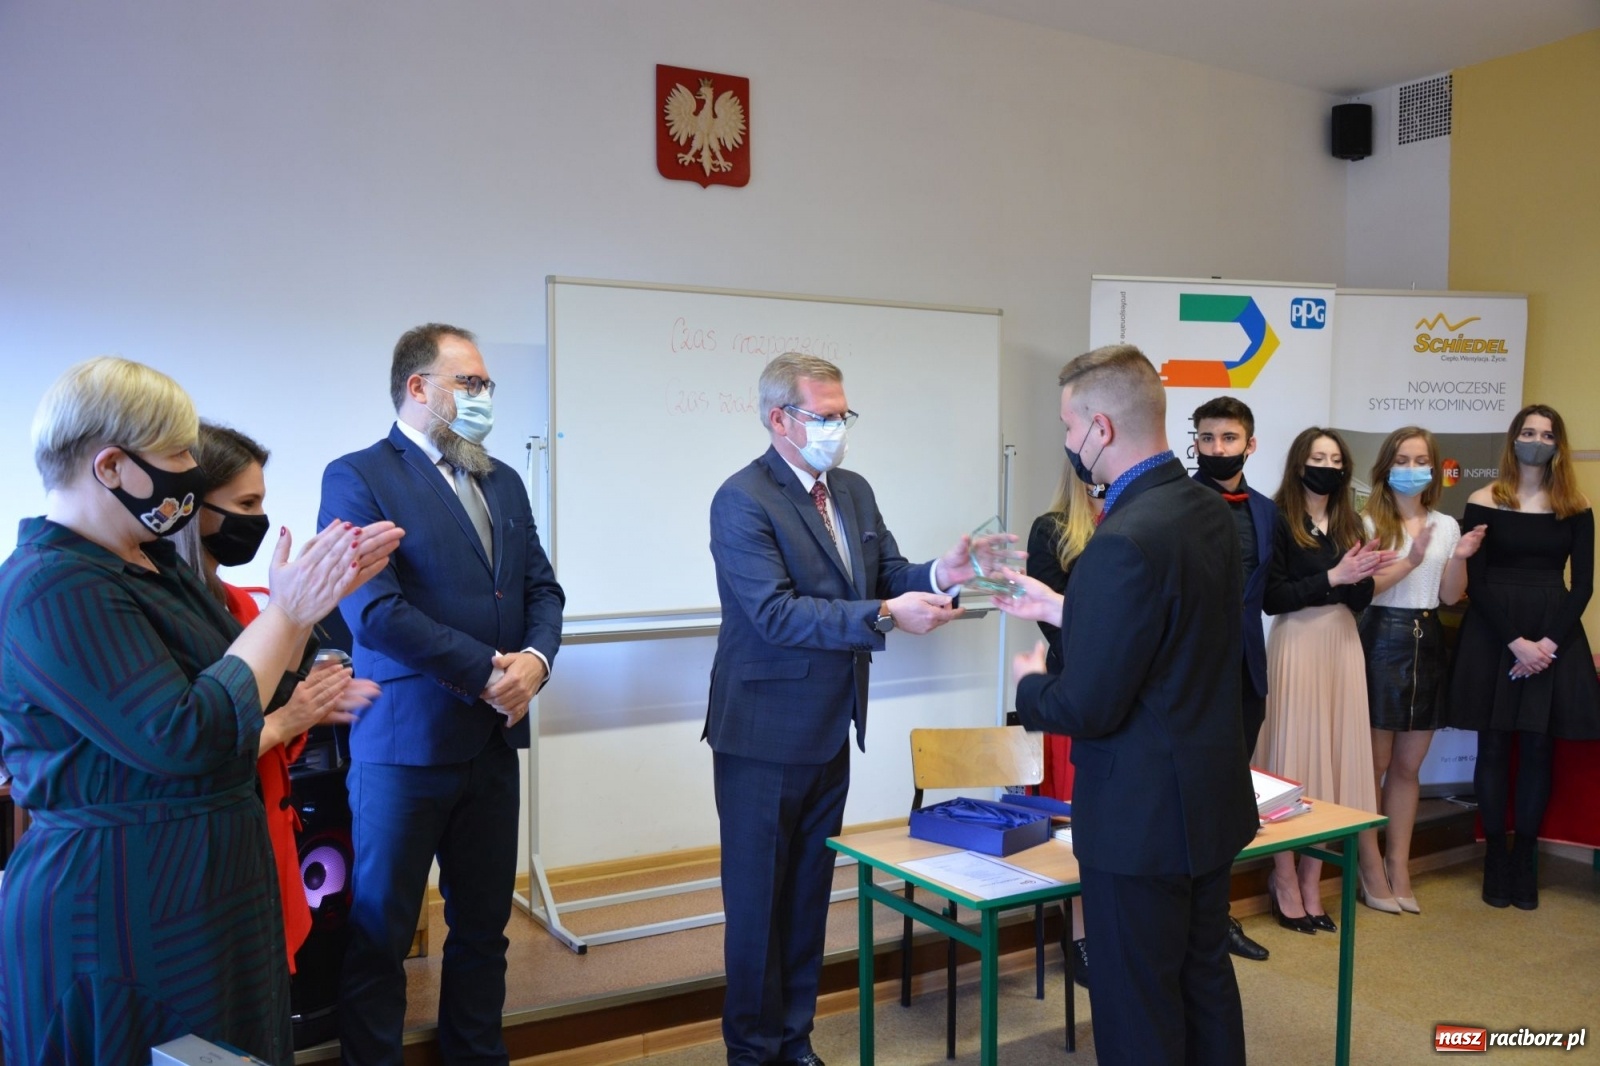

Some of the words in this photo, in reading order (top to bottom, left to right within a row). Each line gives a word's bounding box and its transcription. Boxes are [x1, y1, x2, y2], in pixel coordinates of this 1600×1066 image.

[1291, 300, 1326, 327] PPG
[671, 317, 717, 352] Czas
[1408, 381, 1506, 395] NOWOCZESNE
[1369, 397, 1425, 411] SYSTEMY
[1428, 398, 1506, 412] KOMINOWE
[1443, 468, 1459, 478] IRE
